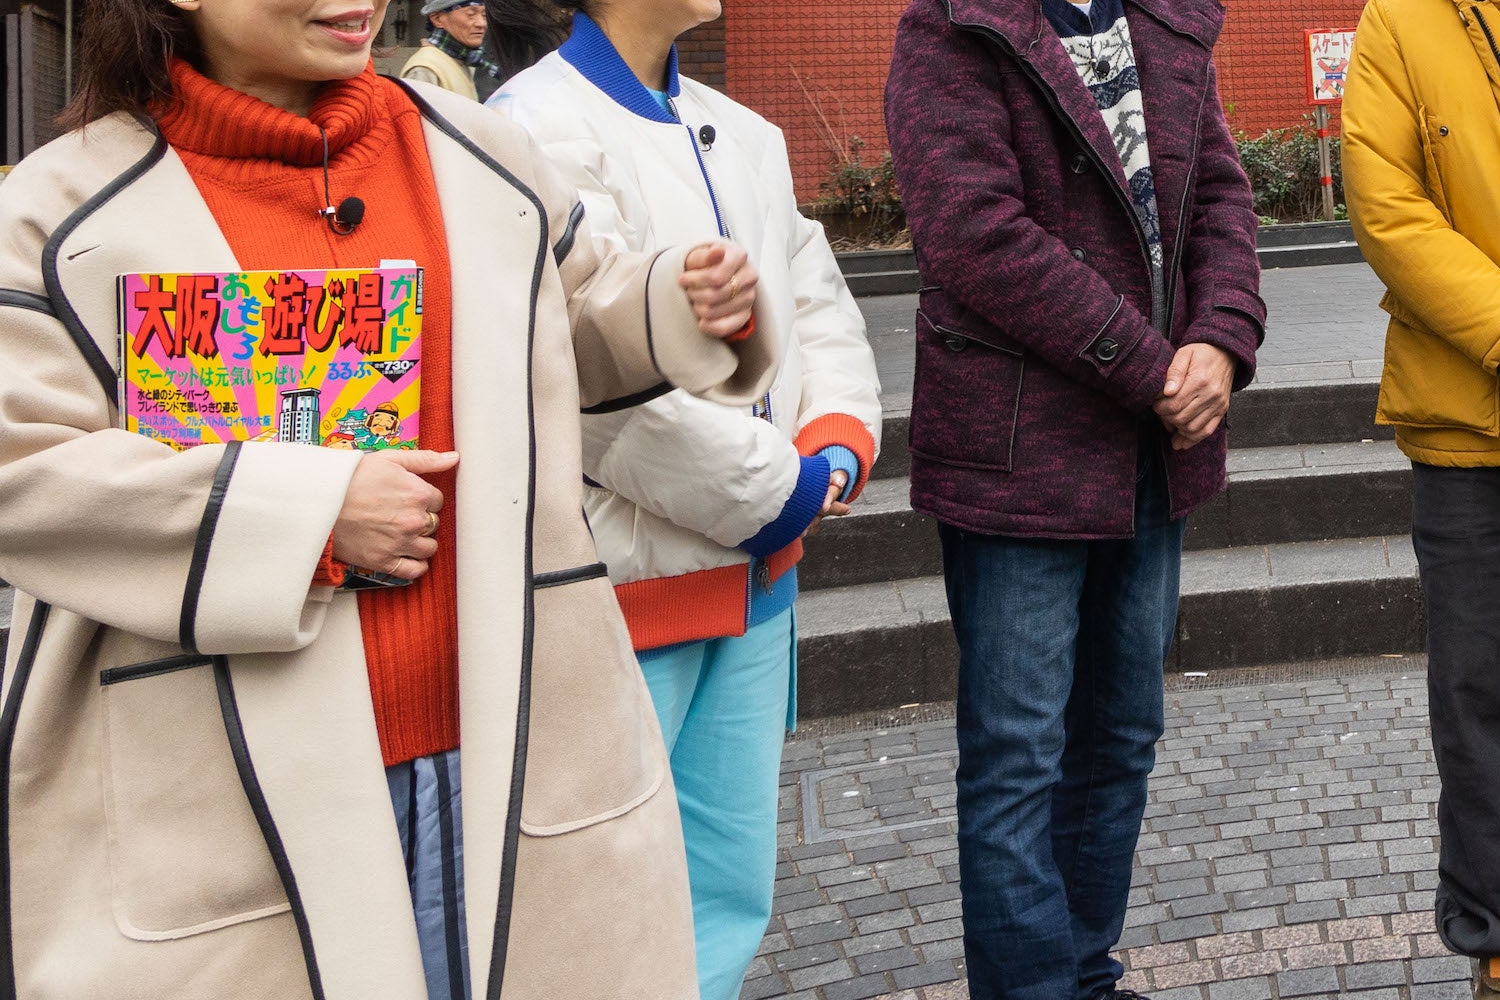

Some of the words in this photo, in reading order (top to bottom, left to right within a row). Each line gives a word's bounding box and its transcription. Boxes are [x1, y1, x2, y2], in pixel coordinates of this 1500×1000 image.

[132, 274, 220, 360] 大阪
[258, 271, 386, 359] 遊び場
[387, 274, 415, 353] ガイド
[327, 361, 372, 381] るるぶ
